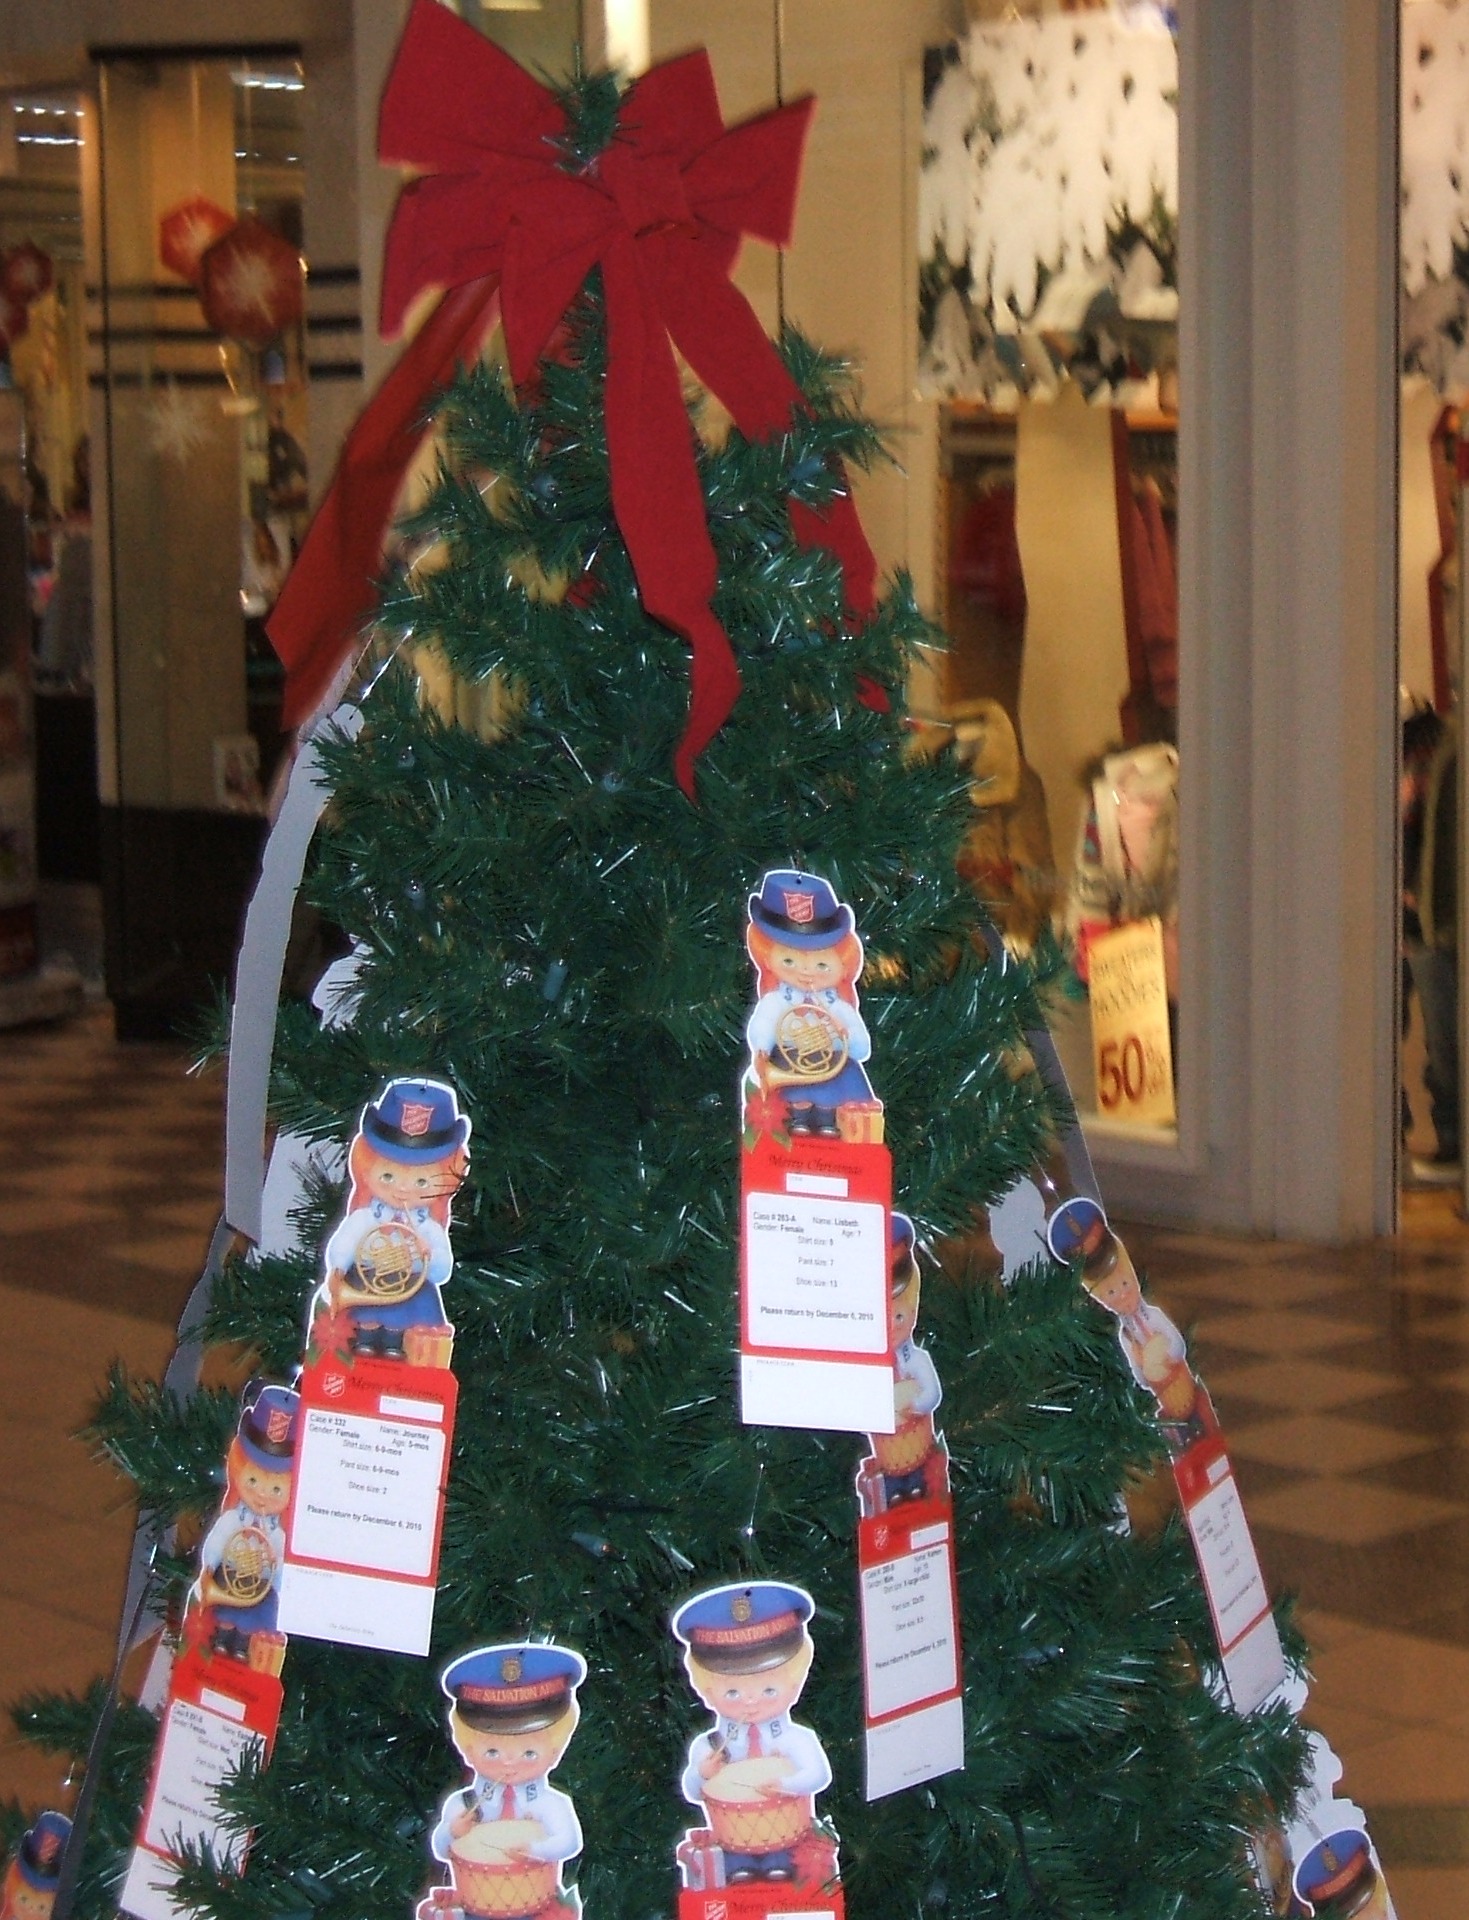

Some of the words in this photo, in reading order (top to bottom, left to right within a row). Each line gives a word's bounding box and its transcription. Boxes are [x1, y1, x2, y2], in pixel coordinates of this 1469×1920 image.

[1100, 1032, 1146, 1110] 50
[769, 1154, 803, 1170] Merry
[753, 1211, 771, 1221] Case
[834, 1218, 860, 1228] Lisbeth
[780, 1224, 805, 1234] Female
[760, 1305, 783, 1316] Please
[784, 1307, 805, 1317] return
[806, 1308, 815, 1319] by
[816, 1309, 850, 1320] December
[310, 1413, 327, 1424] Case
[309, 1423, 334, 1436] Gender:
[335, 1428, 361, 1440] Female
[402, 1428, 430, 1441] Journey
[307, 1504, 329, 1516] Please
[331, 1509, 351, 1520] return
[352, 1511, 361, 1523] by
[362, 1514, 397, 1528] December
[716, 1622, 768, 1645] SALVATION
[481, 1685, 537, 1702] SALVATION
